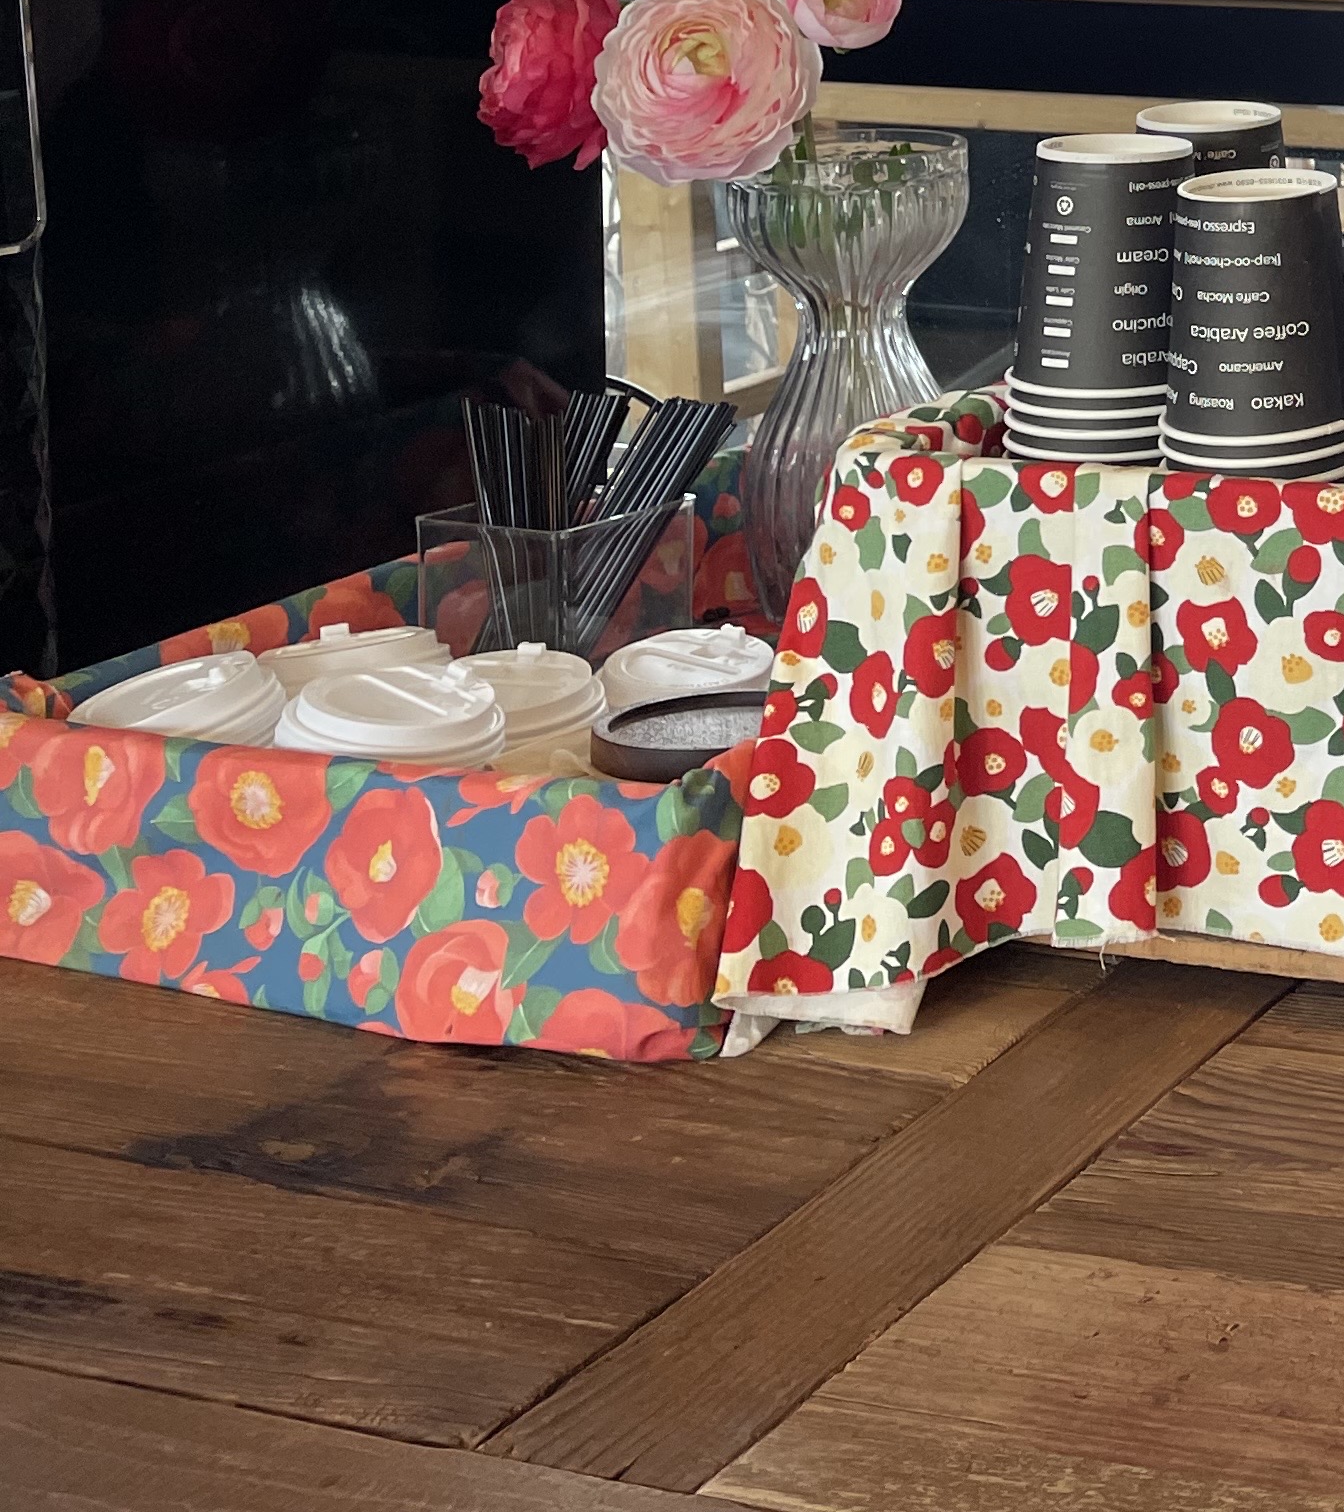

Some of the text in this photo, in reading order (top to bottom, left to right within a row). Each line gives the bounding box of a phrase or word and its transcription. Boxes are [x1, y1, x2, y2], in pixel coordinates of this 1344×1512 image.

[1125, 214, 1163, 227] Aroma
[1202, 219, 1256, 235] Espresso
[1116, 248, 1169, 264] Cream
[1113, 282, 1148, 297] Origin
[1196, 290, 1234, 305] Mocha
[1189, 321, 1310, 343] Coffee Arabica
[1121, 350, 1170, 368] Arabia
[1218, 360, 1284, 375] Americano
[1188, 392, 1235, 411] Roasting
[1250, 392, 1305, 411] Kakao
